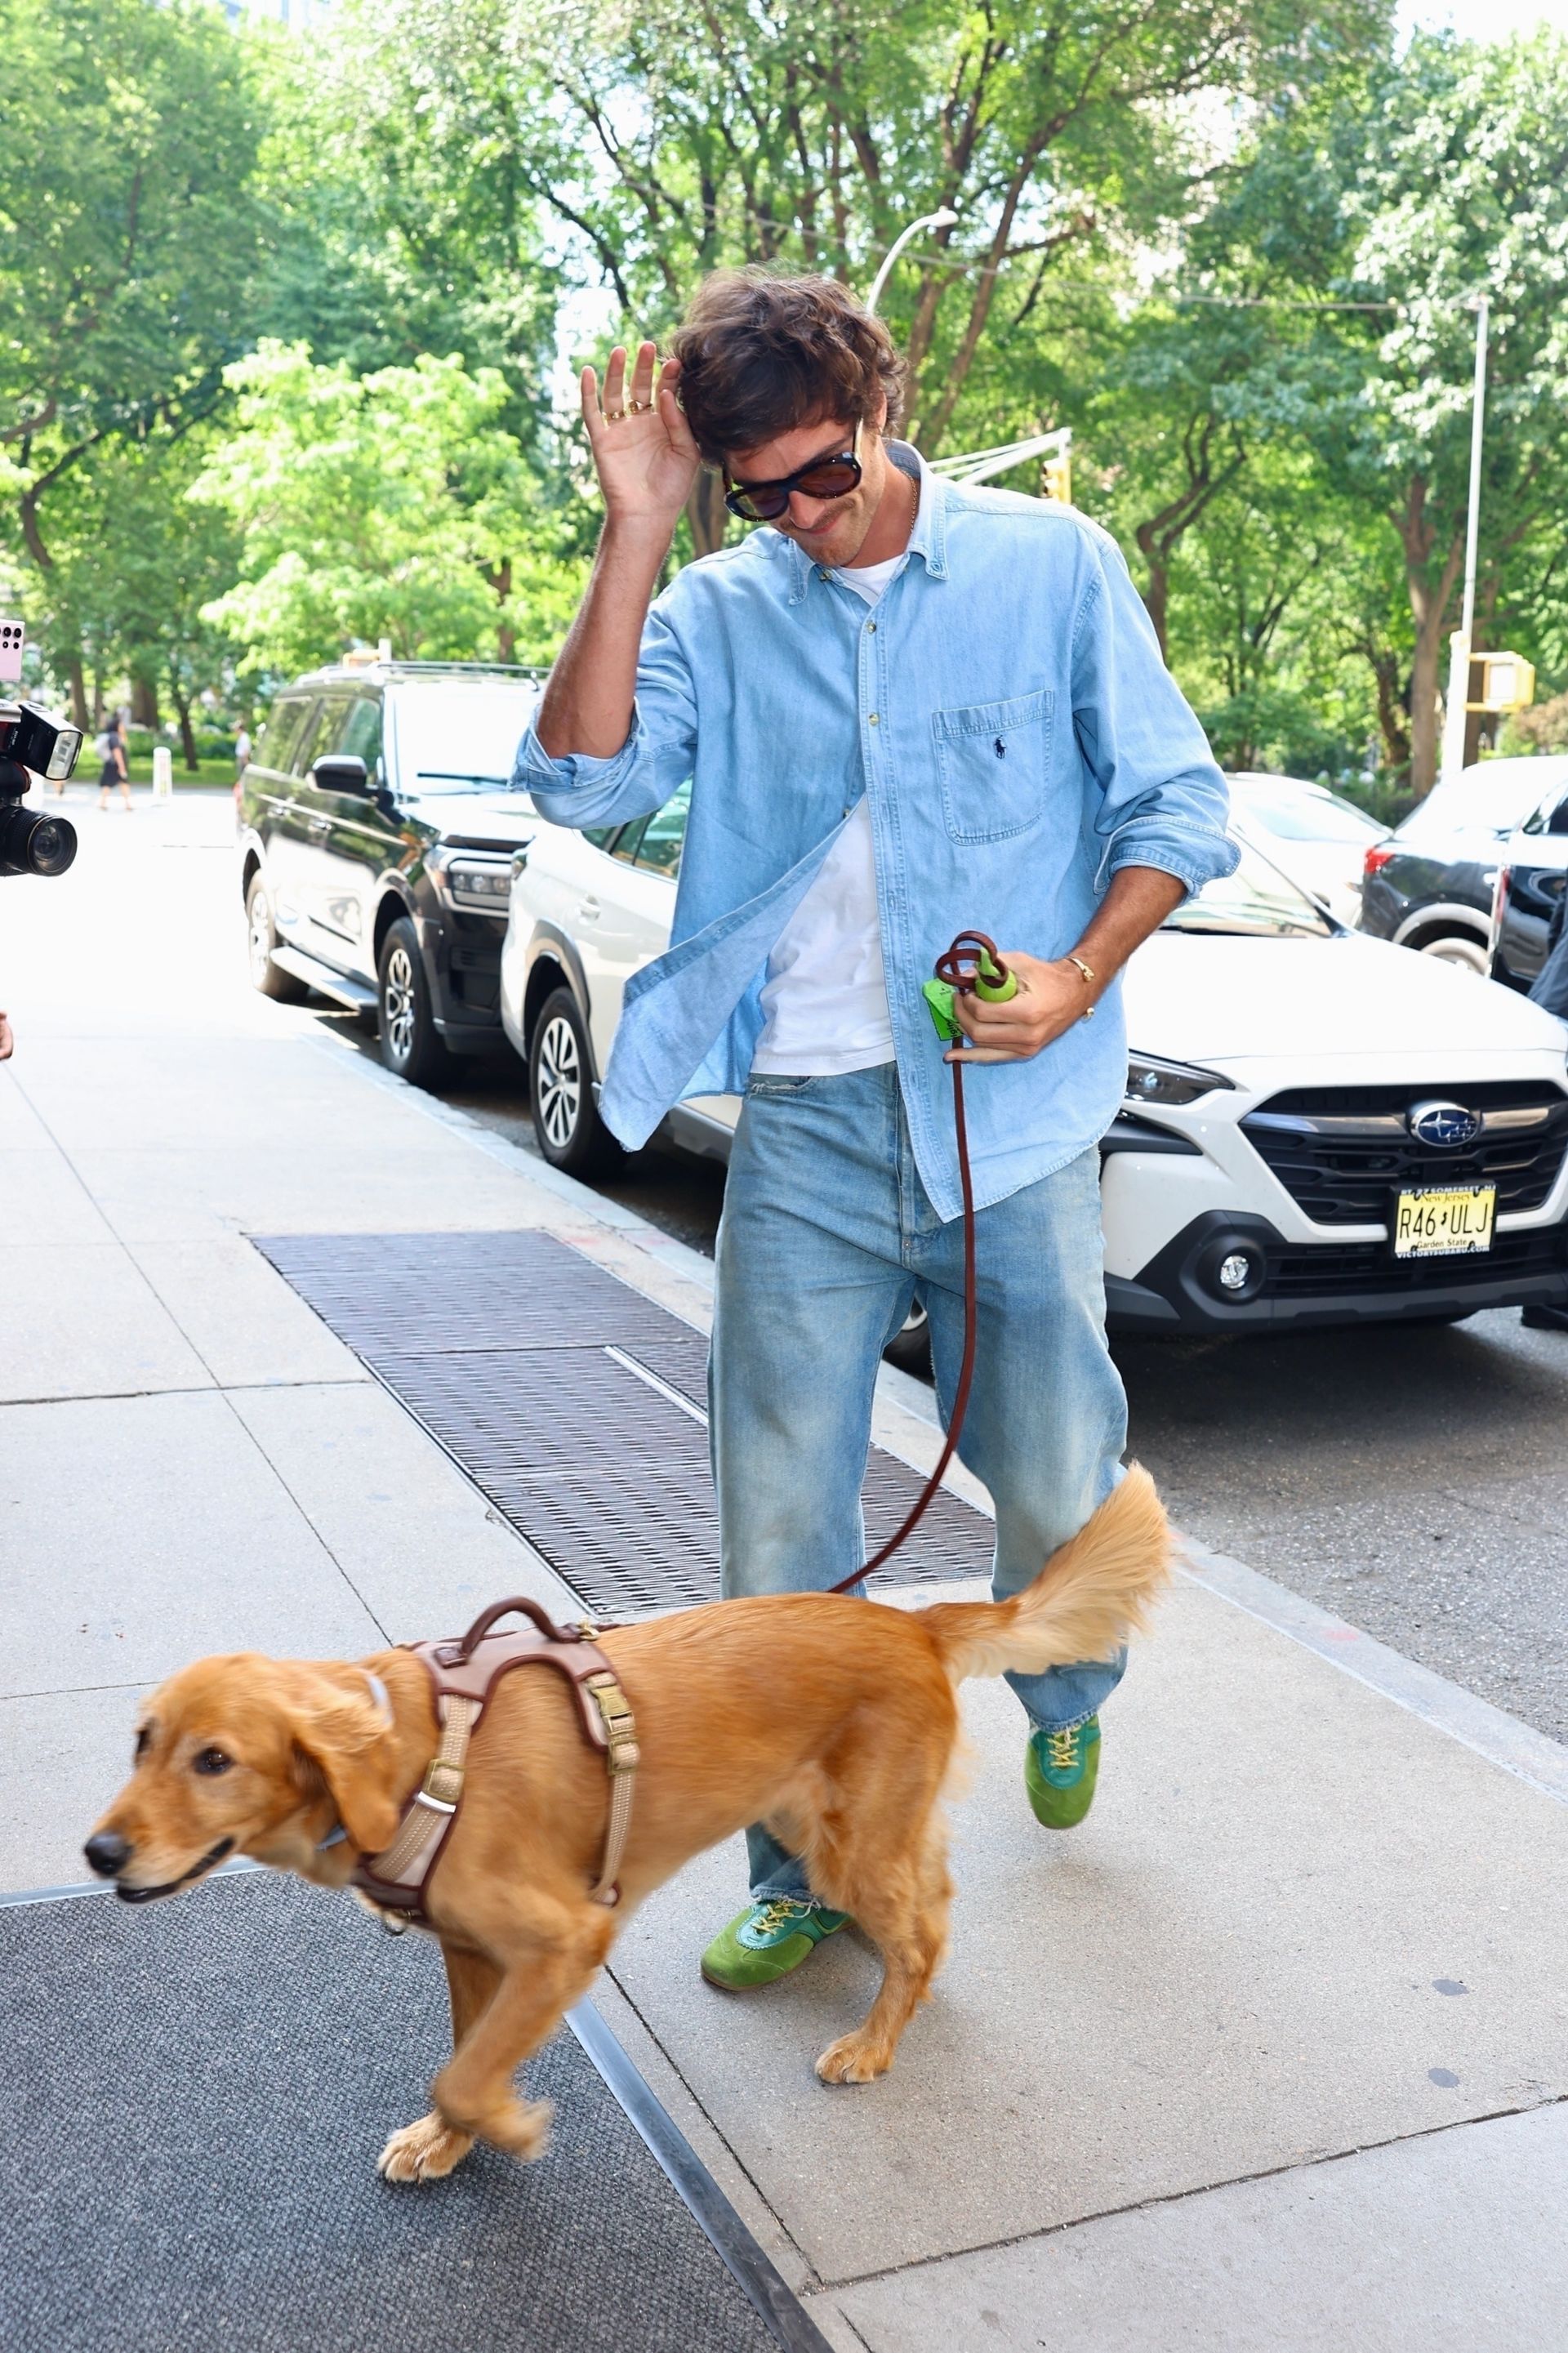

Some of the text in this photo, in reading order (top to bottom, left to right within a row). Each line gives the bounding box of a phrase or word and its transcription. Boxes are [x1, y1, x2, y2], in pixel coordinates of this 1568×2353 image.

[1421, 1192, 1471, 1204] New Jersey
[1399, 1203, 1488, 1238] R46 ULJ
[1417, 1238, 1468, 1249] Garden State
